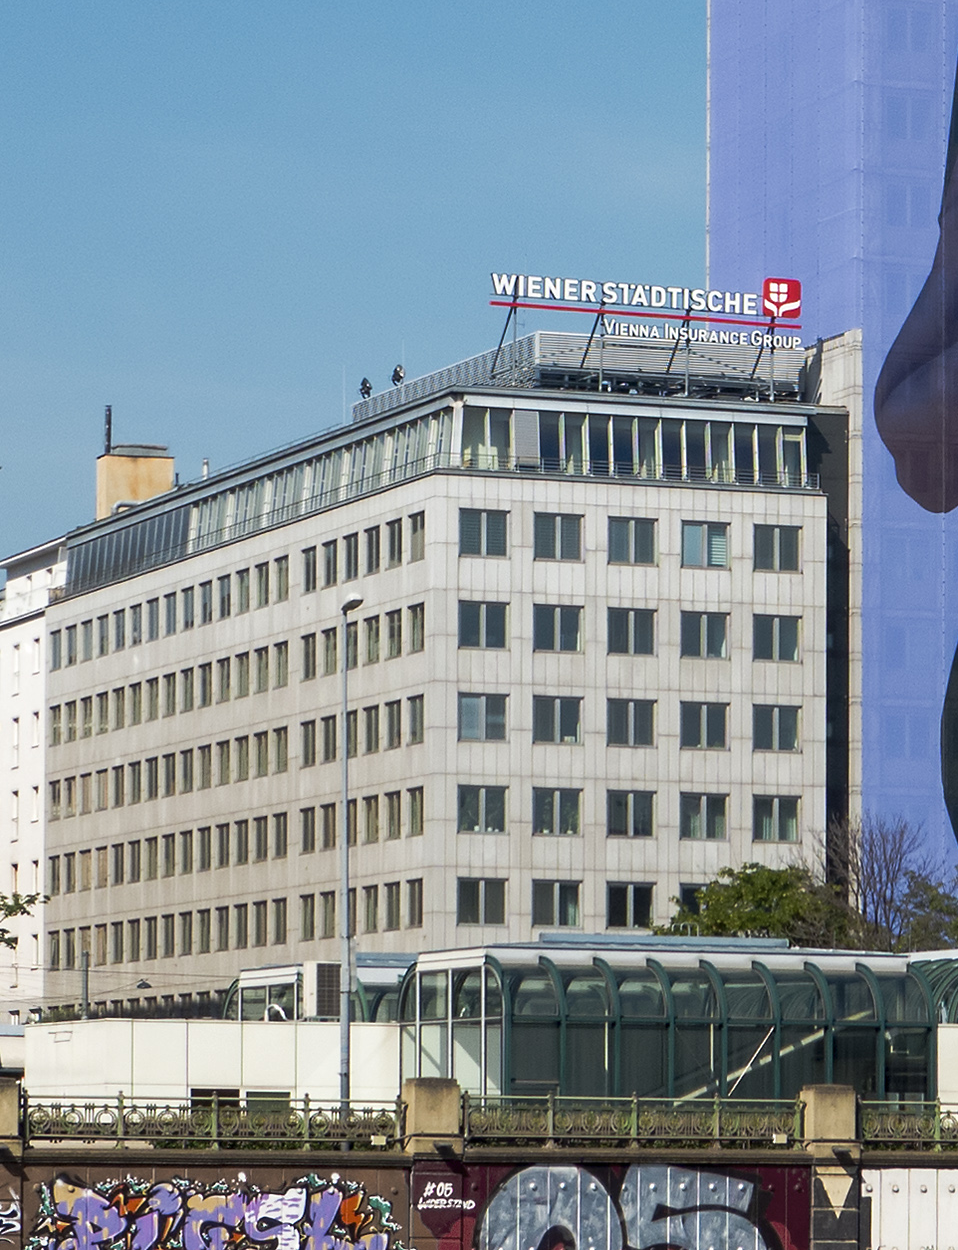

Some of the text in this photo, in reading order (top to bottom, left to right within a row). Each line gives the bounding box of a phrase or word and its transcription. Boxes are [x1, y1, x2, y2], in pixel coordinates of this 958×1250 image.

[491, 272, 758, 315] WIENER STÄDTISCHE
[603, 318, 802, 349] VIENNA INSURANCE GROUP
